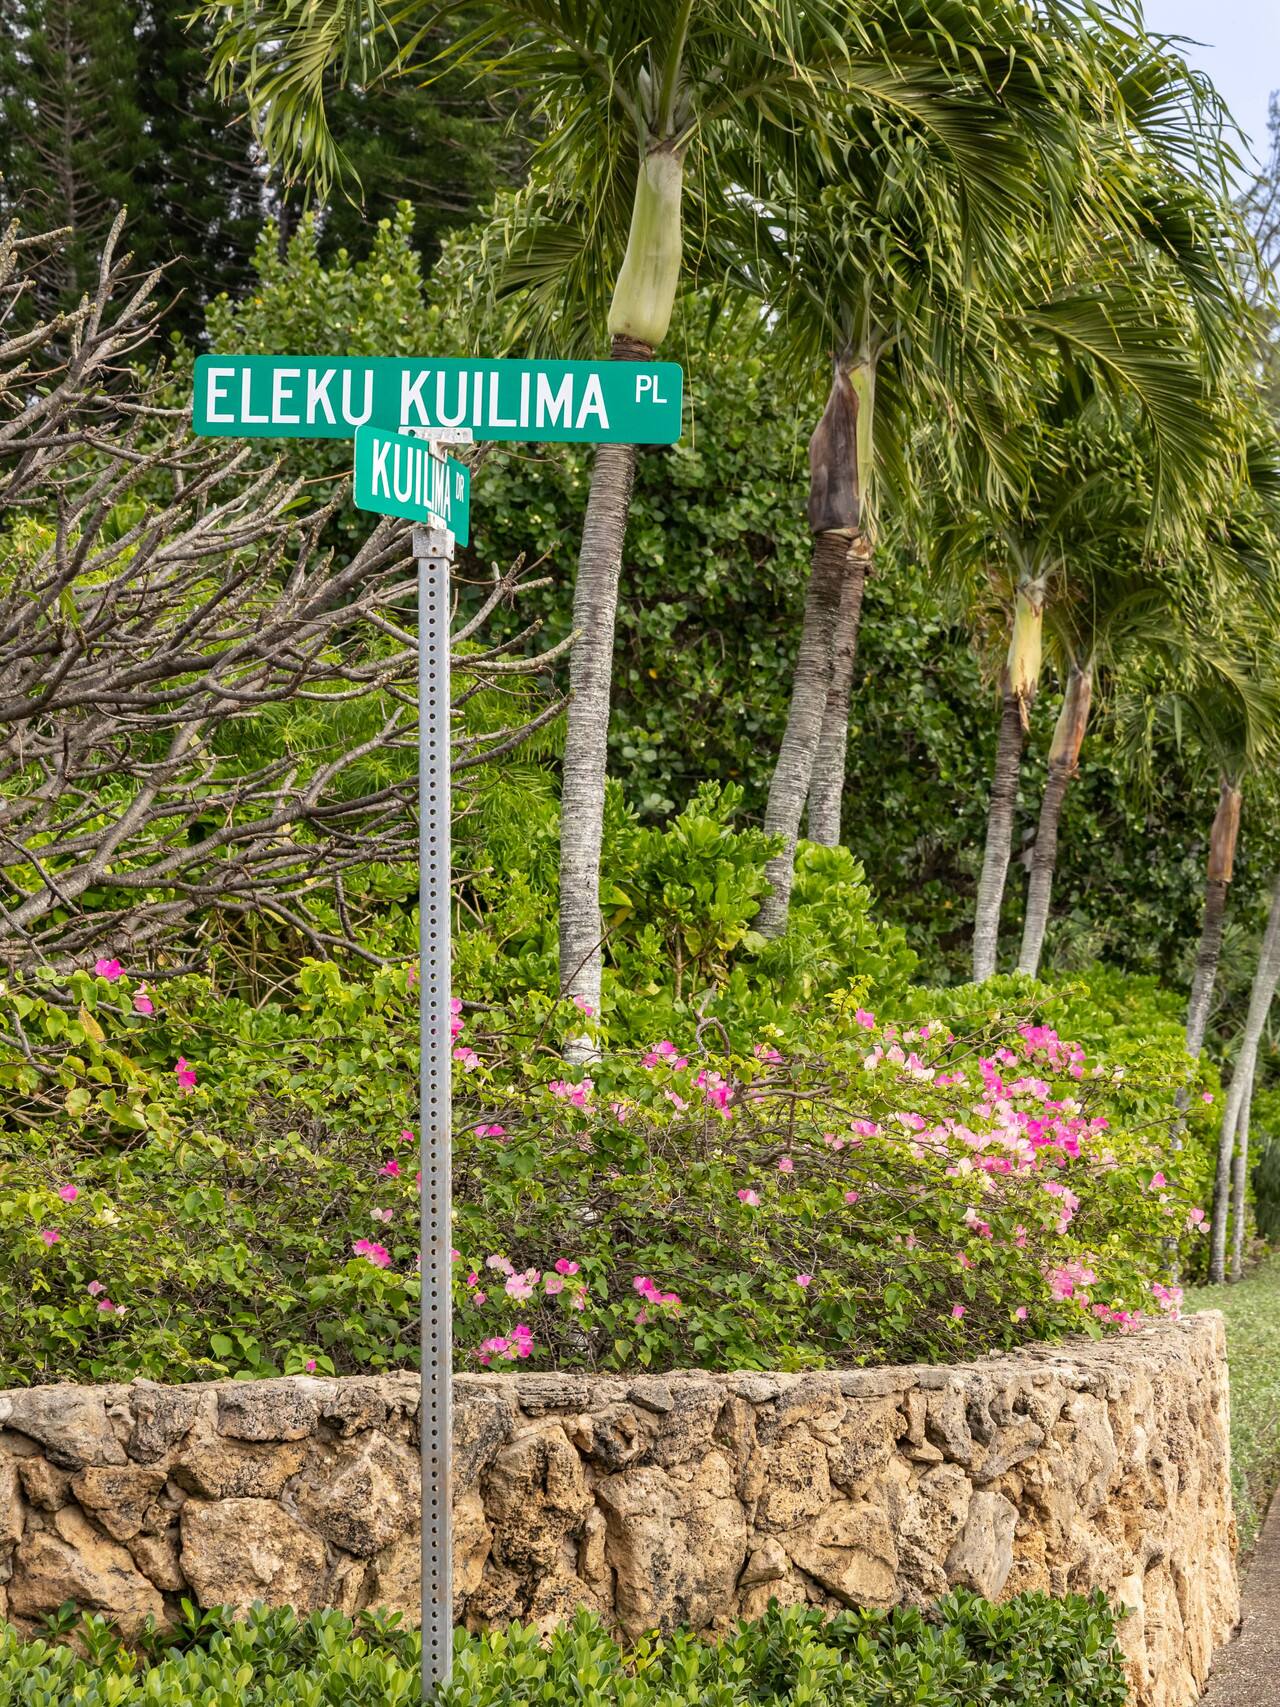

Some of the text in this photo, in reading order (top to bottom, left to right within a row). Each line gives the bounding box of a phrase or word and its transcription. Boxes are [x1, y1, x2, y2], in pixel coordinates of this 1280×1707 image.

[206, 368, 668, 429] ELEKU KUILIMA PL
[371, 438, 465, 522] KUILIMA DR
